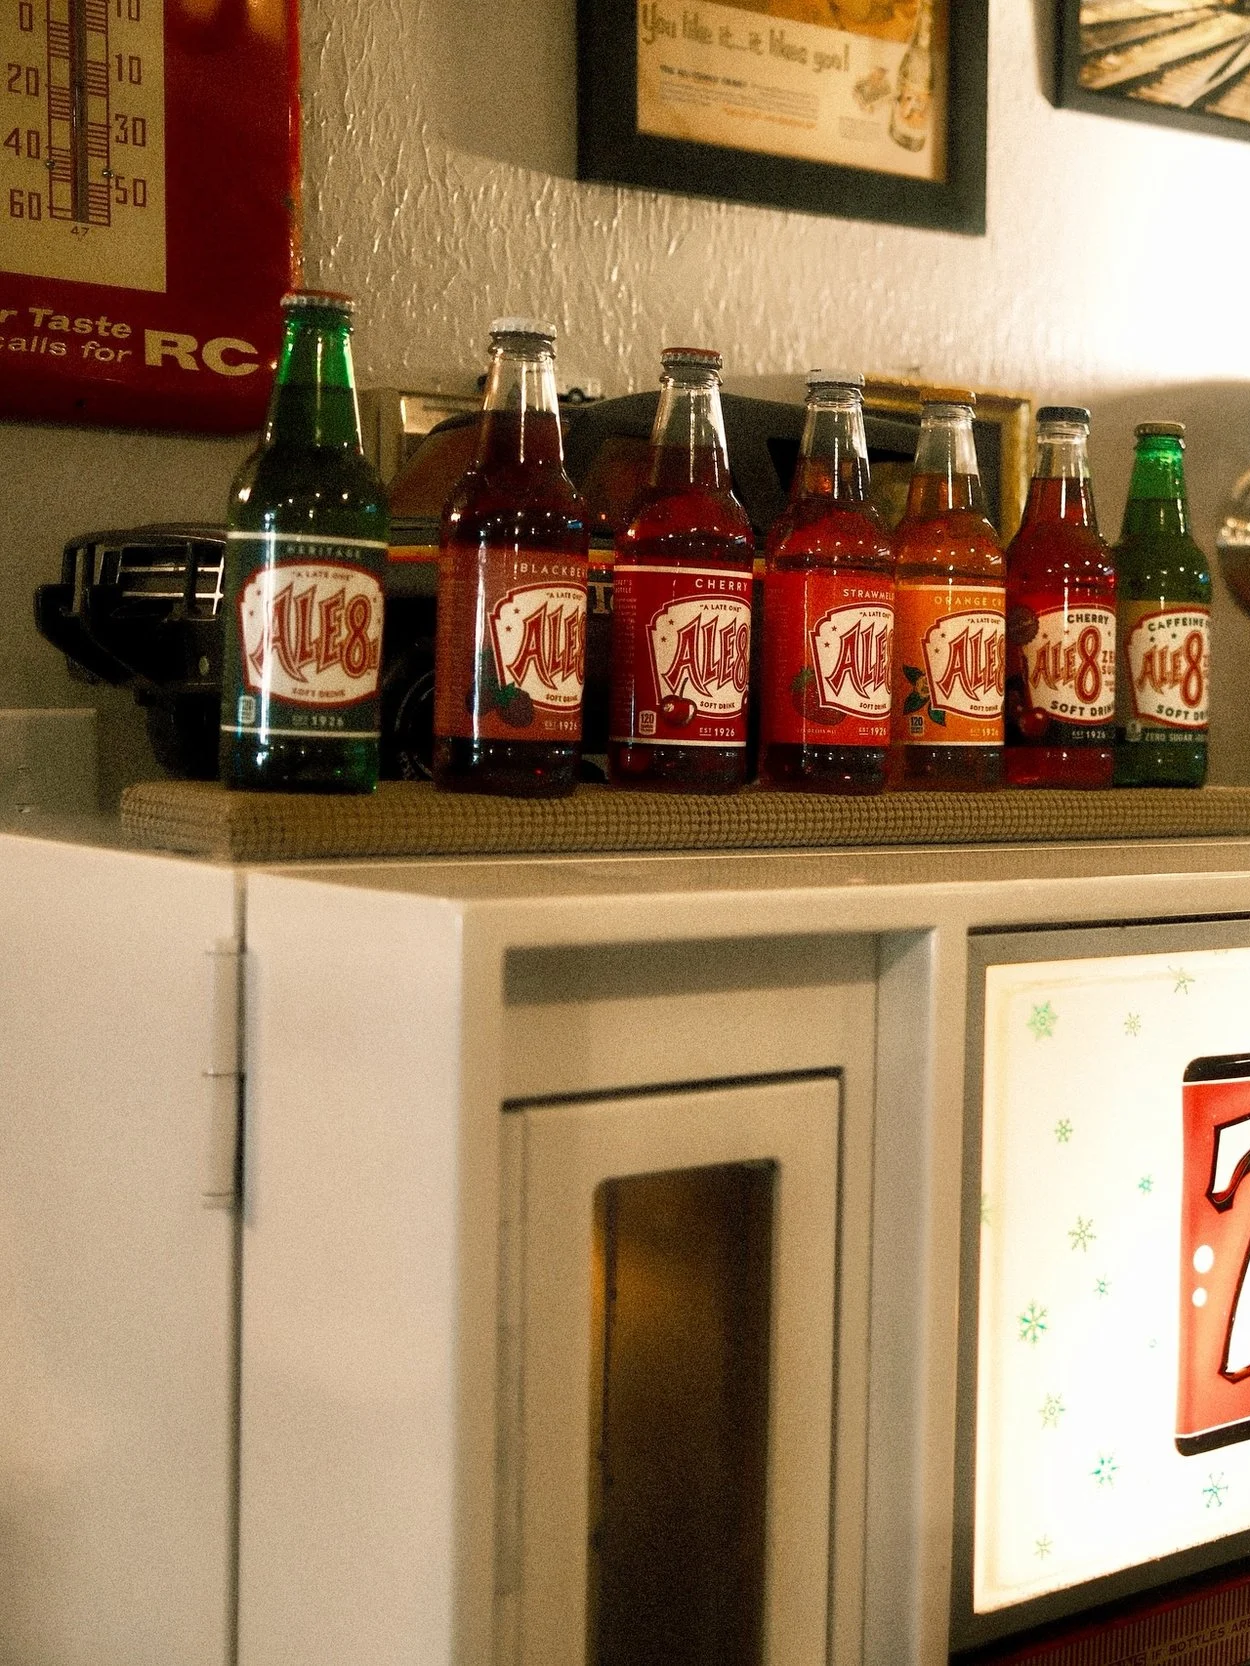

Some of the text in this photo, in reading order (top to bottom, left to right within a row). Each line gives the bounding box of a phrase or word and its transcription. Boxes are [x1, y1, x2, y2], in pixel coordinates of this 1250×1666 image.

[7, 63, 39, 97] 20
[115, 53, 141, 85] 10
[115, 113, 146, 147] 30
[3, 127, 40, 160] 40
[115, 175, 146, 207] 50
[9, 189, 42, 221] 60
[70, 226, 89, 237] 47
[29, 307, 132, 339] Taste
[81, 340, 133, 363] for
[144, 328, 259, 376] RC
[695, 579, 747, 592] CHERRY
[935, 595, 987, 607] ORANGE
[1067, 613, 1109, 625] CHERRY
[1147, 617, 1203, 632] CAFFEINE
[661, 613, 748, 698] ALE8
[700, 701, 717, 709] SOFT
[1050, 700, 1085, 717] SOFT
[1156, 704, 1190, 721] SOFT
[714, 727, 735, 737] 1926
[1169, 1626, 1225, 1653] BOTTLES
